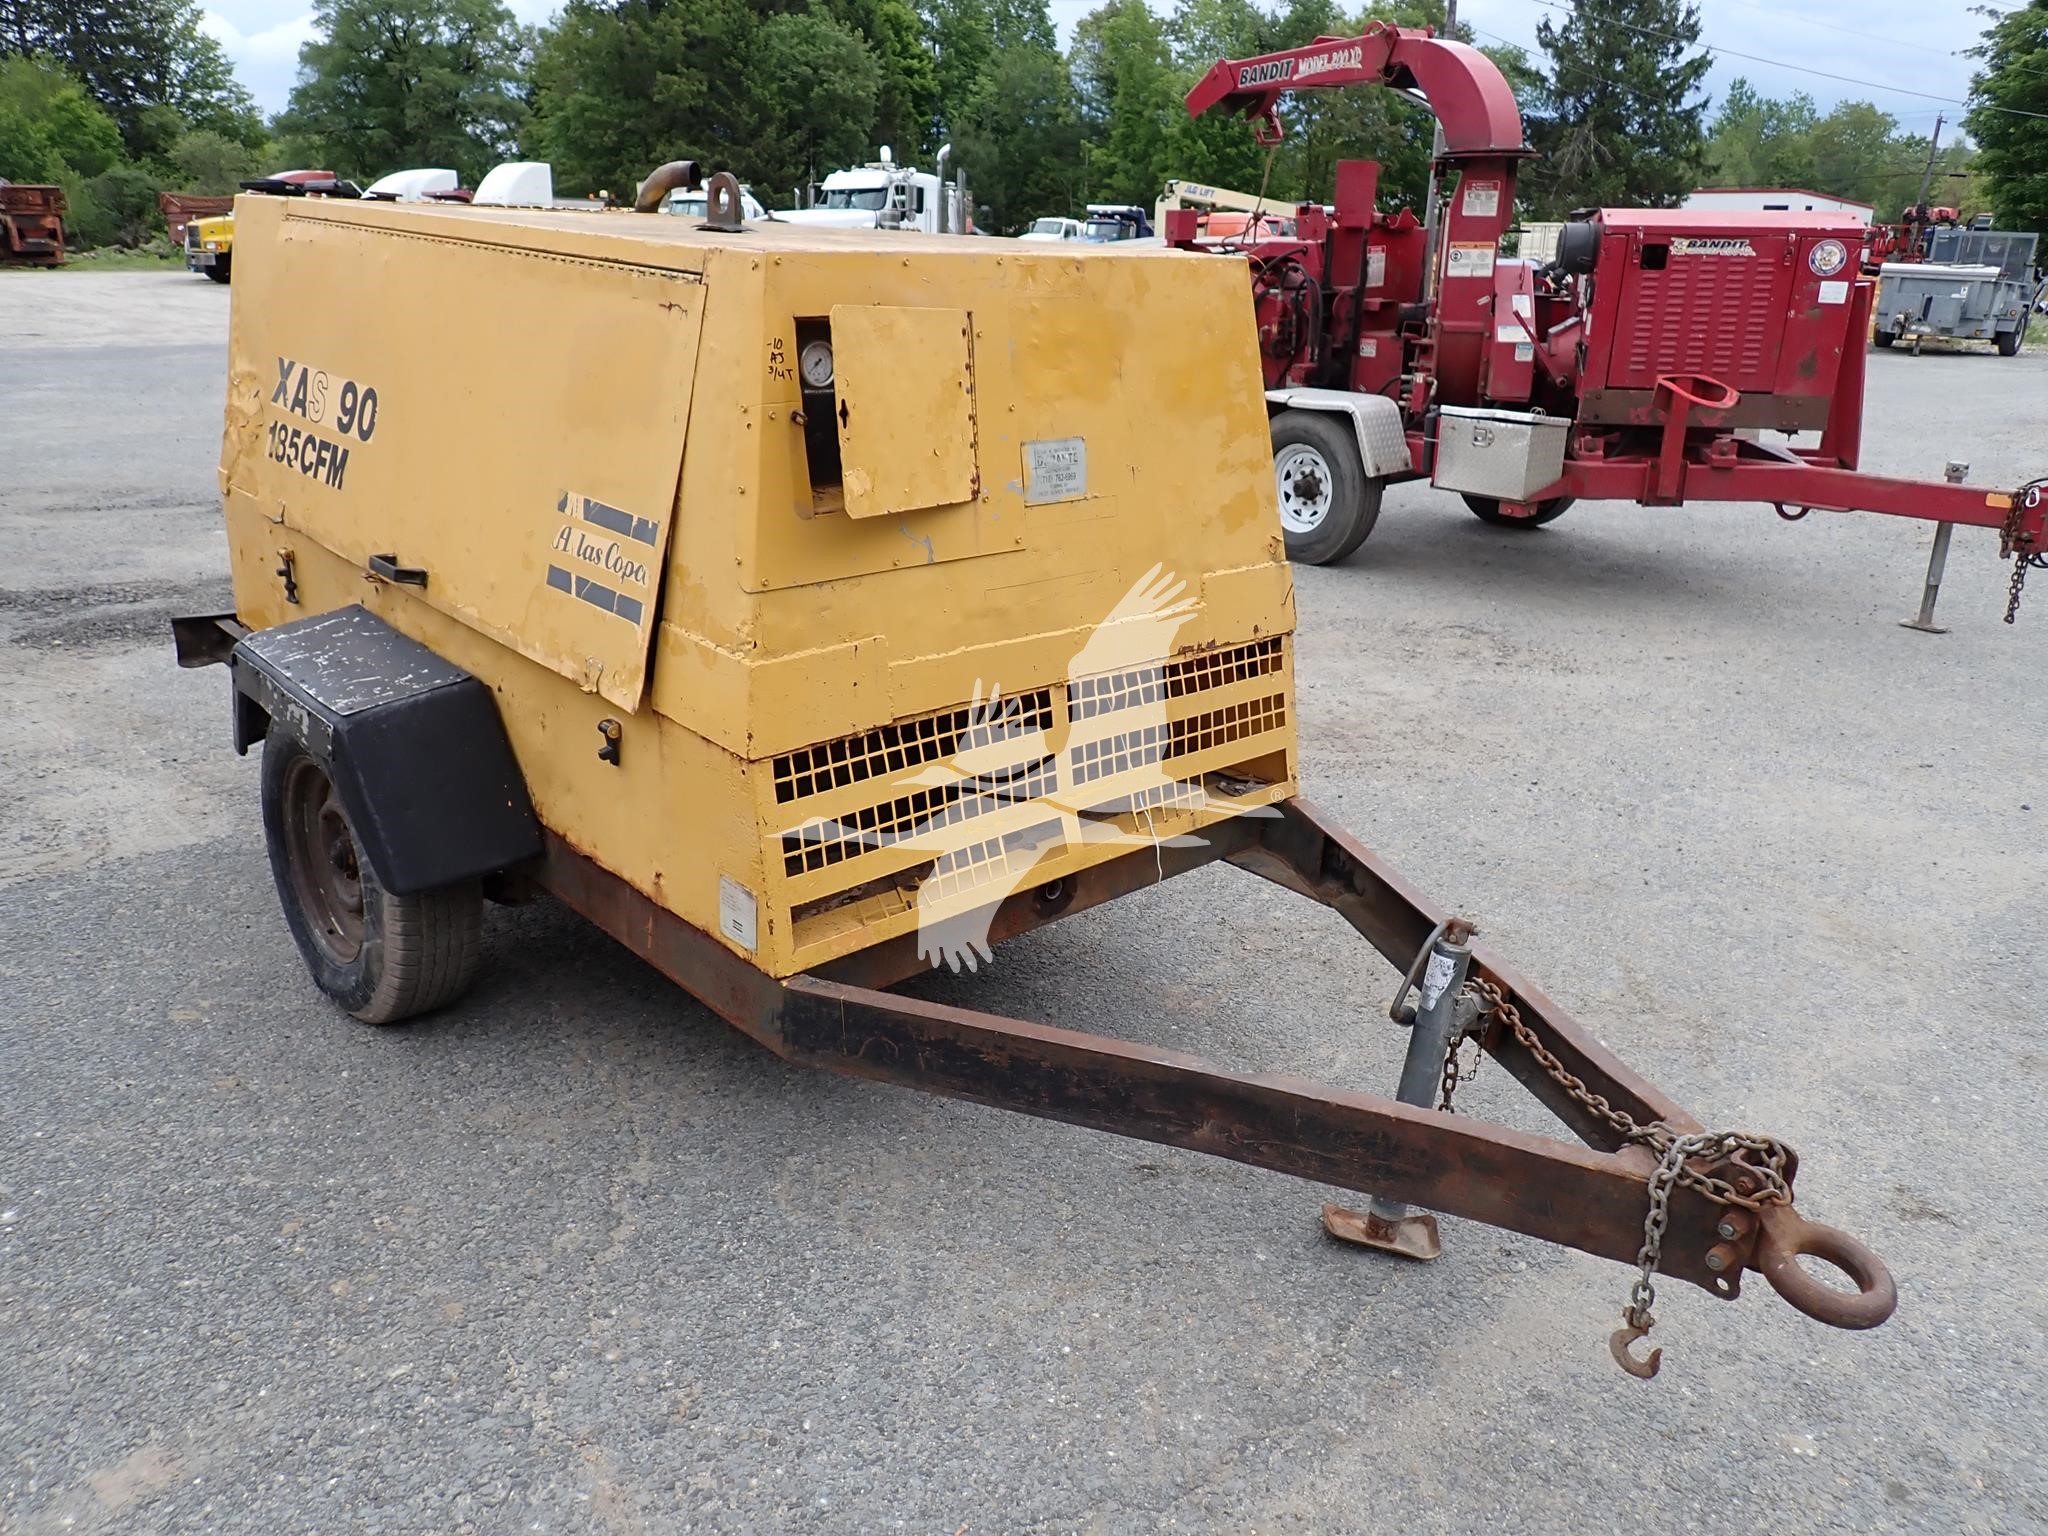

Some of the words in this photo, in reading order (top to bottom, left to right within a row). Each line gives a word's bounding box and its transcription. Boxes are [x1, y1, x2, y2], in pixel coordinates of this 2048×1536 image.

[1239, 59, 1294, 87] BANDIT
[1686, 240, 1748, 249] BANDIT
[271, 356, 328, 424] XAS
[336, 380, 378, 443] 90
[268, 420, 350, 491] 185CFM
